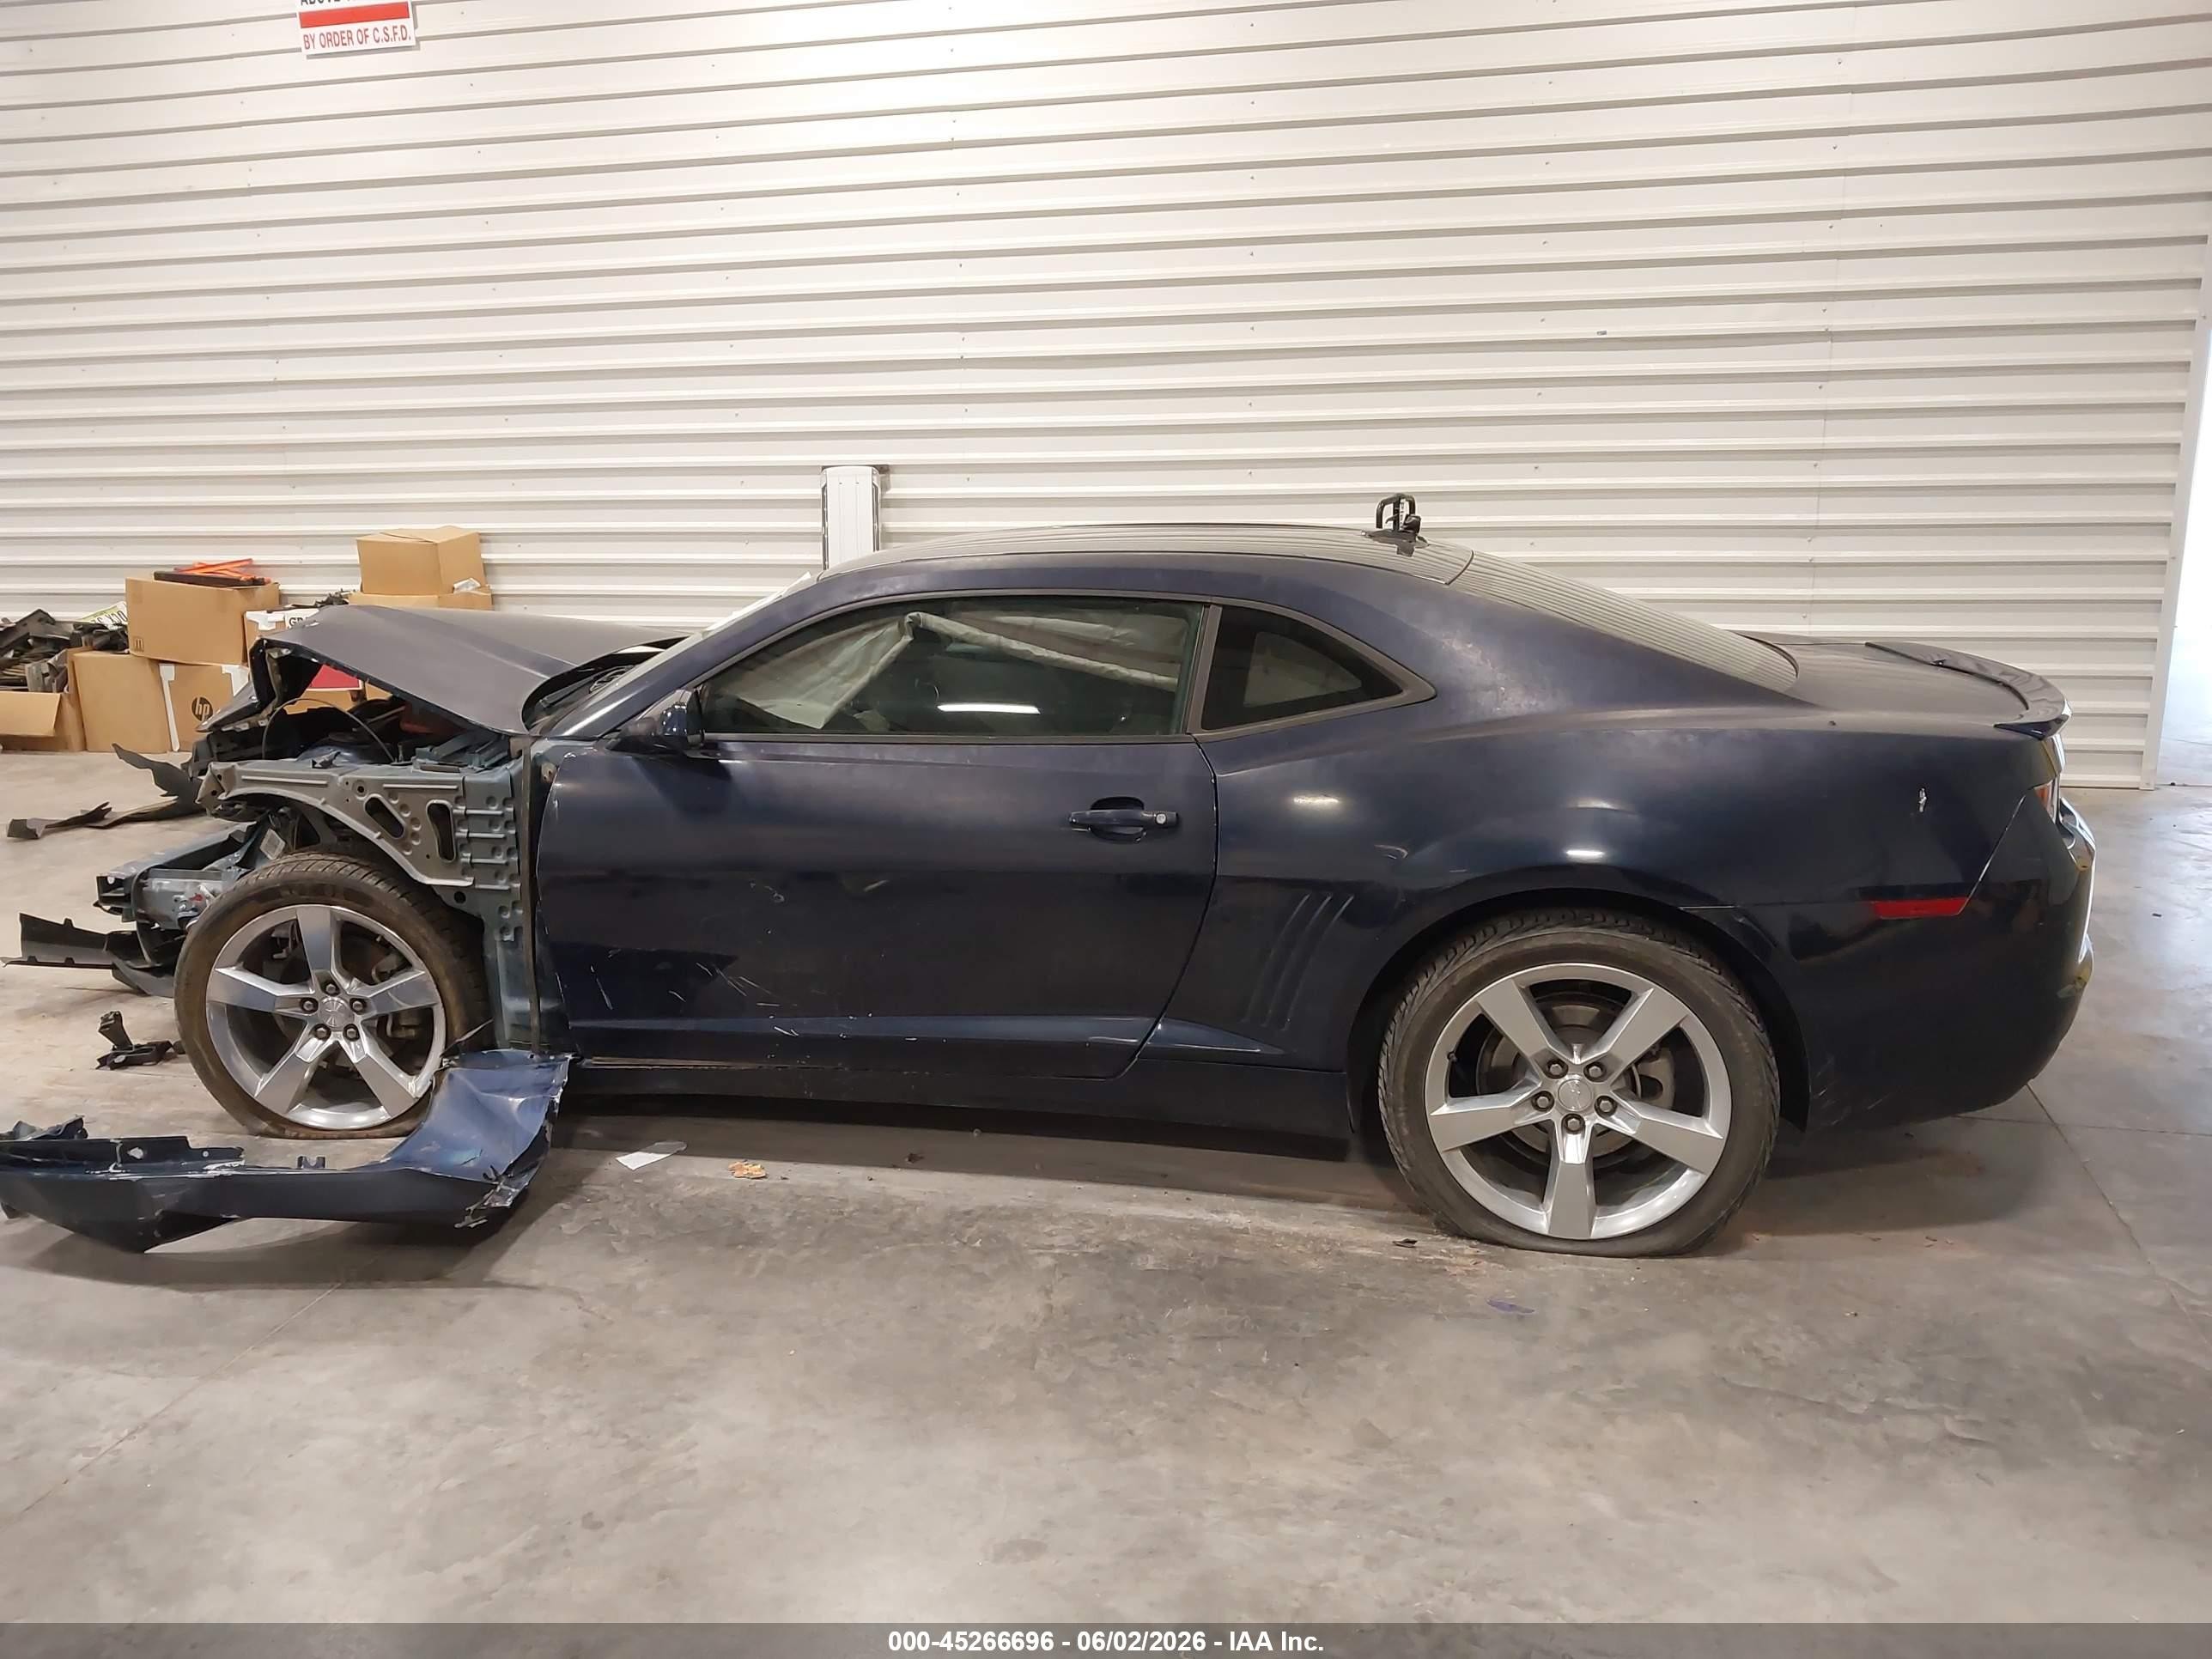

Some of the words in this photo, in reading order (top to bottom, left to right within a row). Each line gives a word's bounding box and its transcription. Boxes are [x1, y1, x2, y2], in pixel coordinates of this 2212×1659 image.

[303, 33, 316, 50] BY
[319, 30, 355, 48] ORDER
[356, 27, 369, 45] OF
[373, 25, 411, 43] C.S.F.D.
[194, 696, 210, 721] hp
